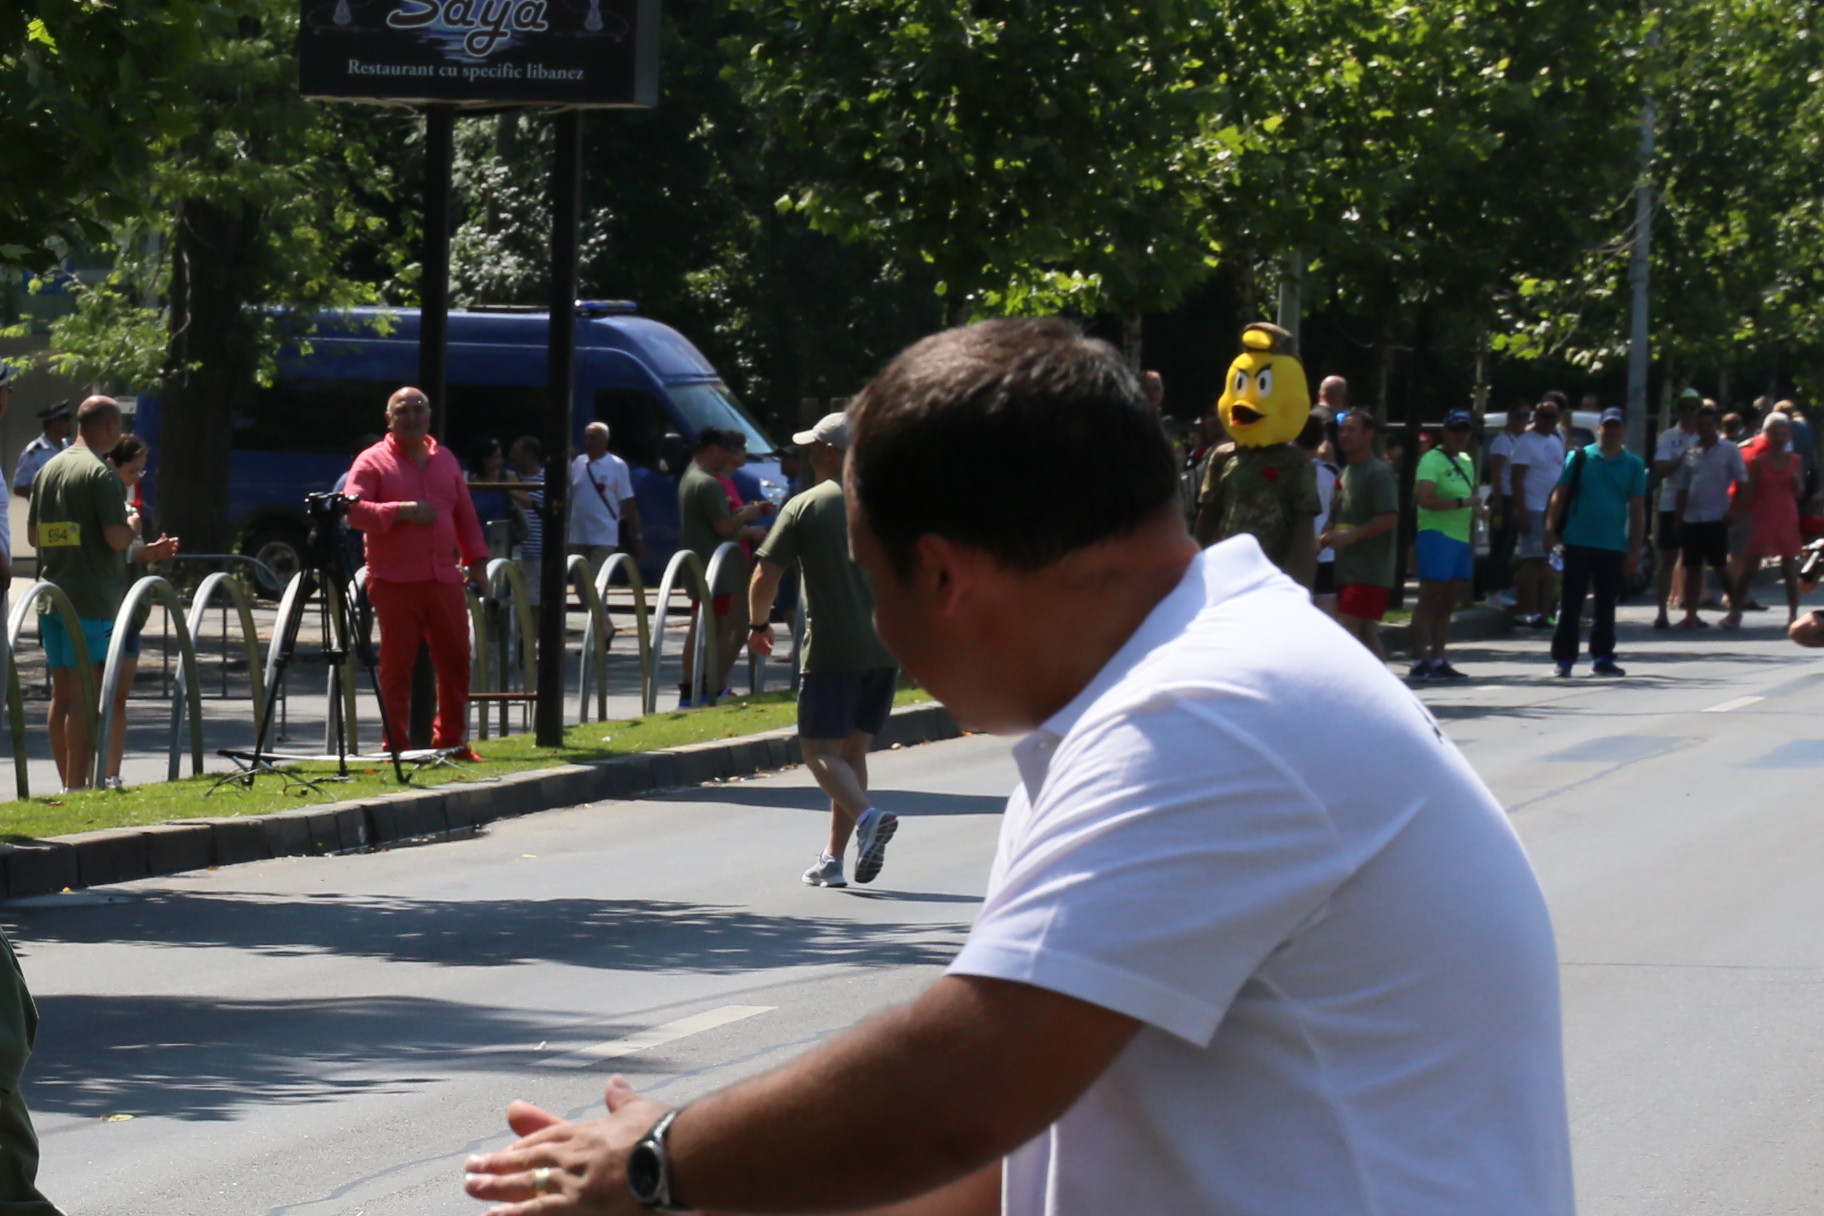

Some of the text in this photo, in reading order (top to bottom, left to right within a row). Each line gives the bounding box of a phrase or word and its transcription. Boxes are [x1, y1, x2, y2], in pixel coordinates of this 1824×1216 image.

[386, 0, 549, 57] Saya
[348, 59, 584, 82] Restaurant cu specific libanez
